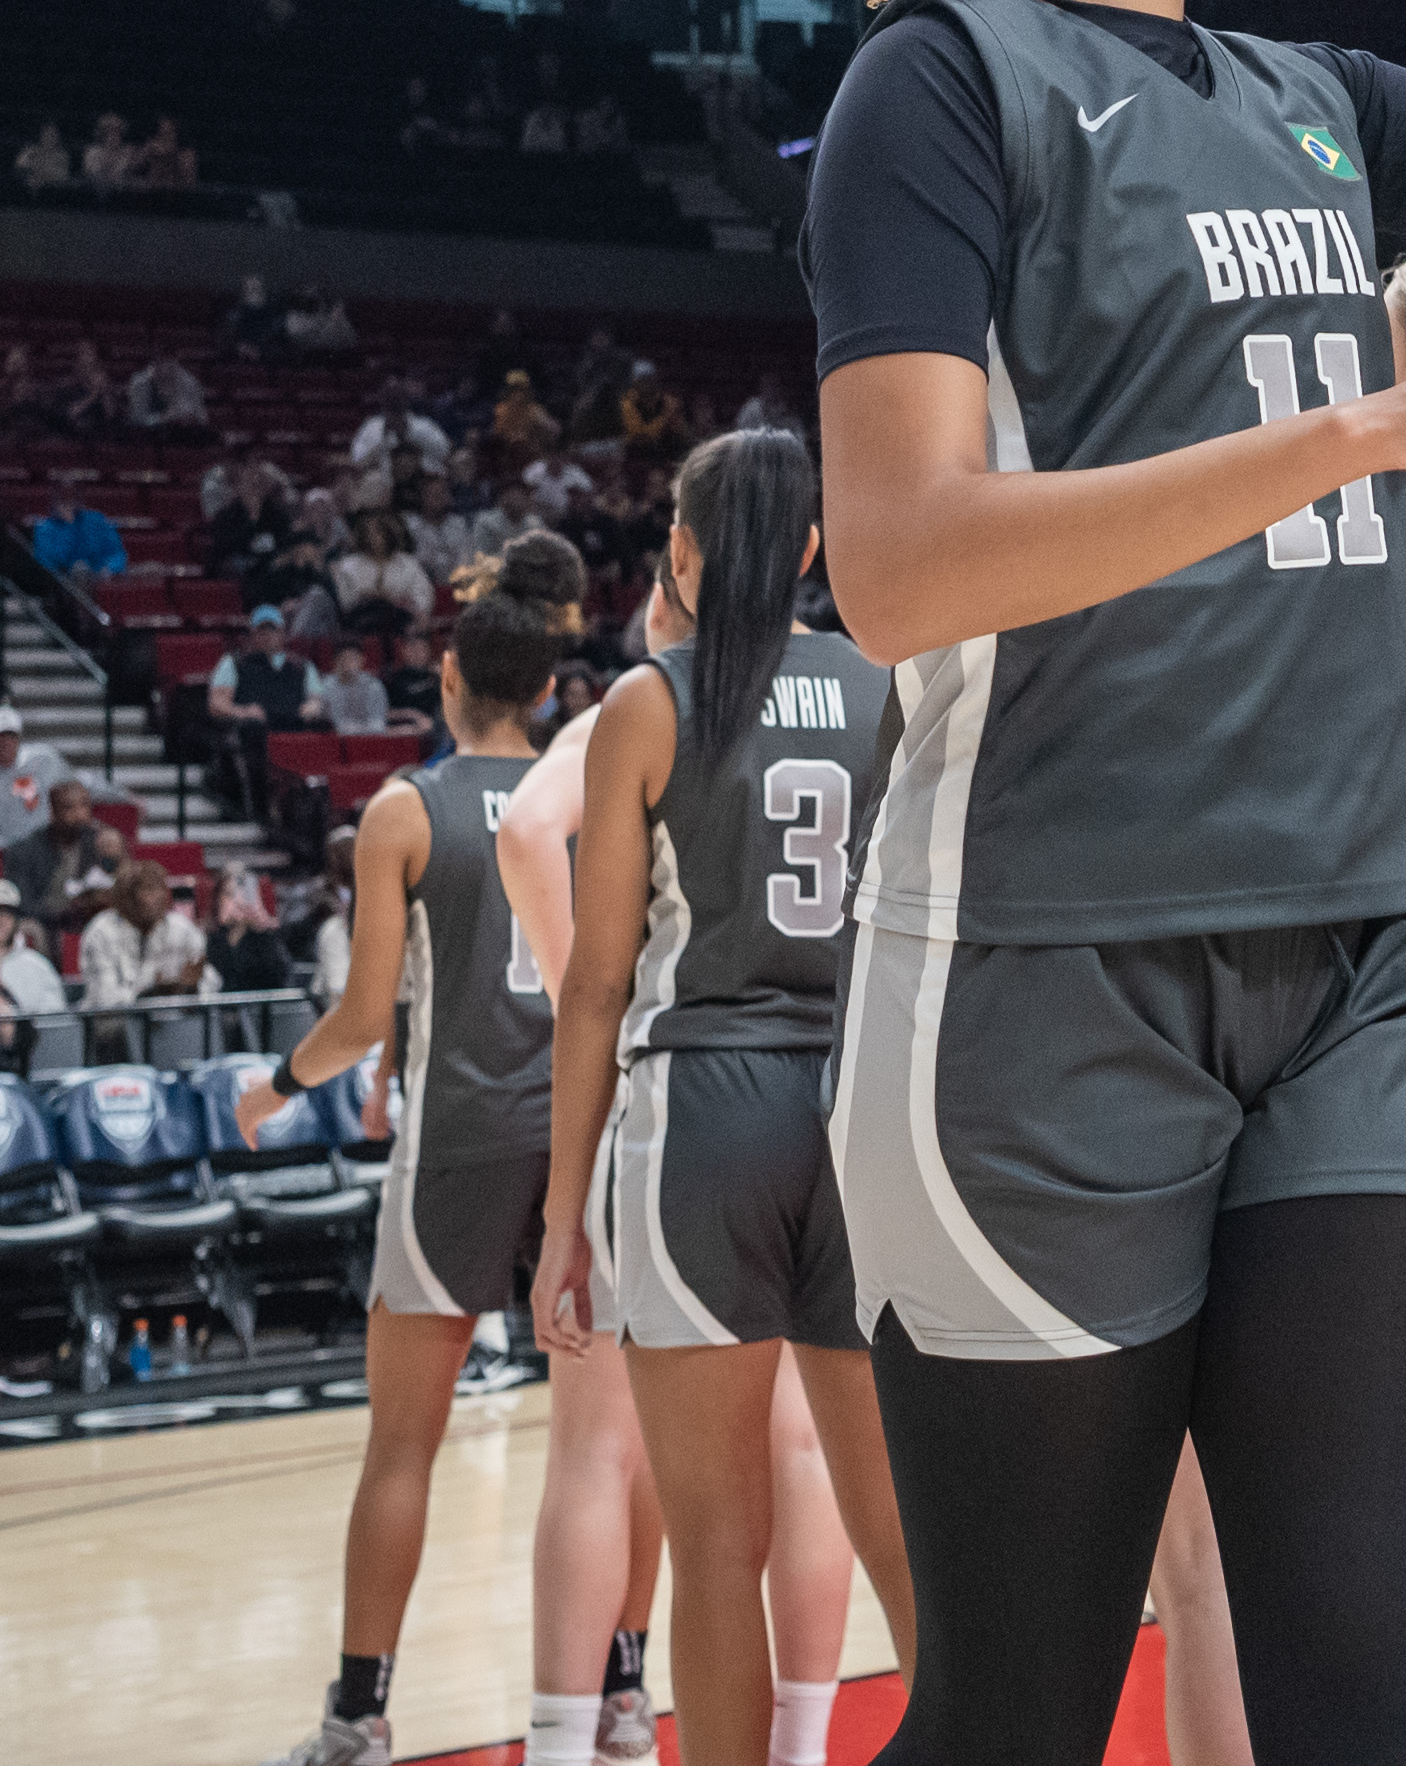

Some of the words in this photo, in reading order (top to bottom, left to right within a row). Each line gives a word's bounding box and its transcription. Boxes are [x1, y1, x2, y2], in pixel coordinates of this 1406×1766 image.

[1186, 208, 1376, 303] BRAZIL
[1242, 332, 1388, 570] 11
[763, 758, 852, 938] 3
